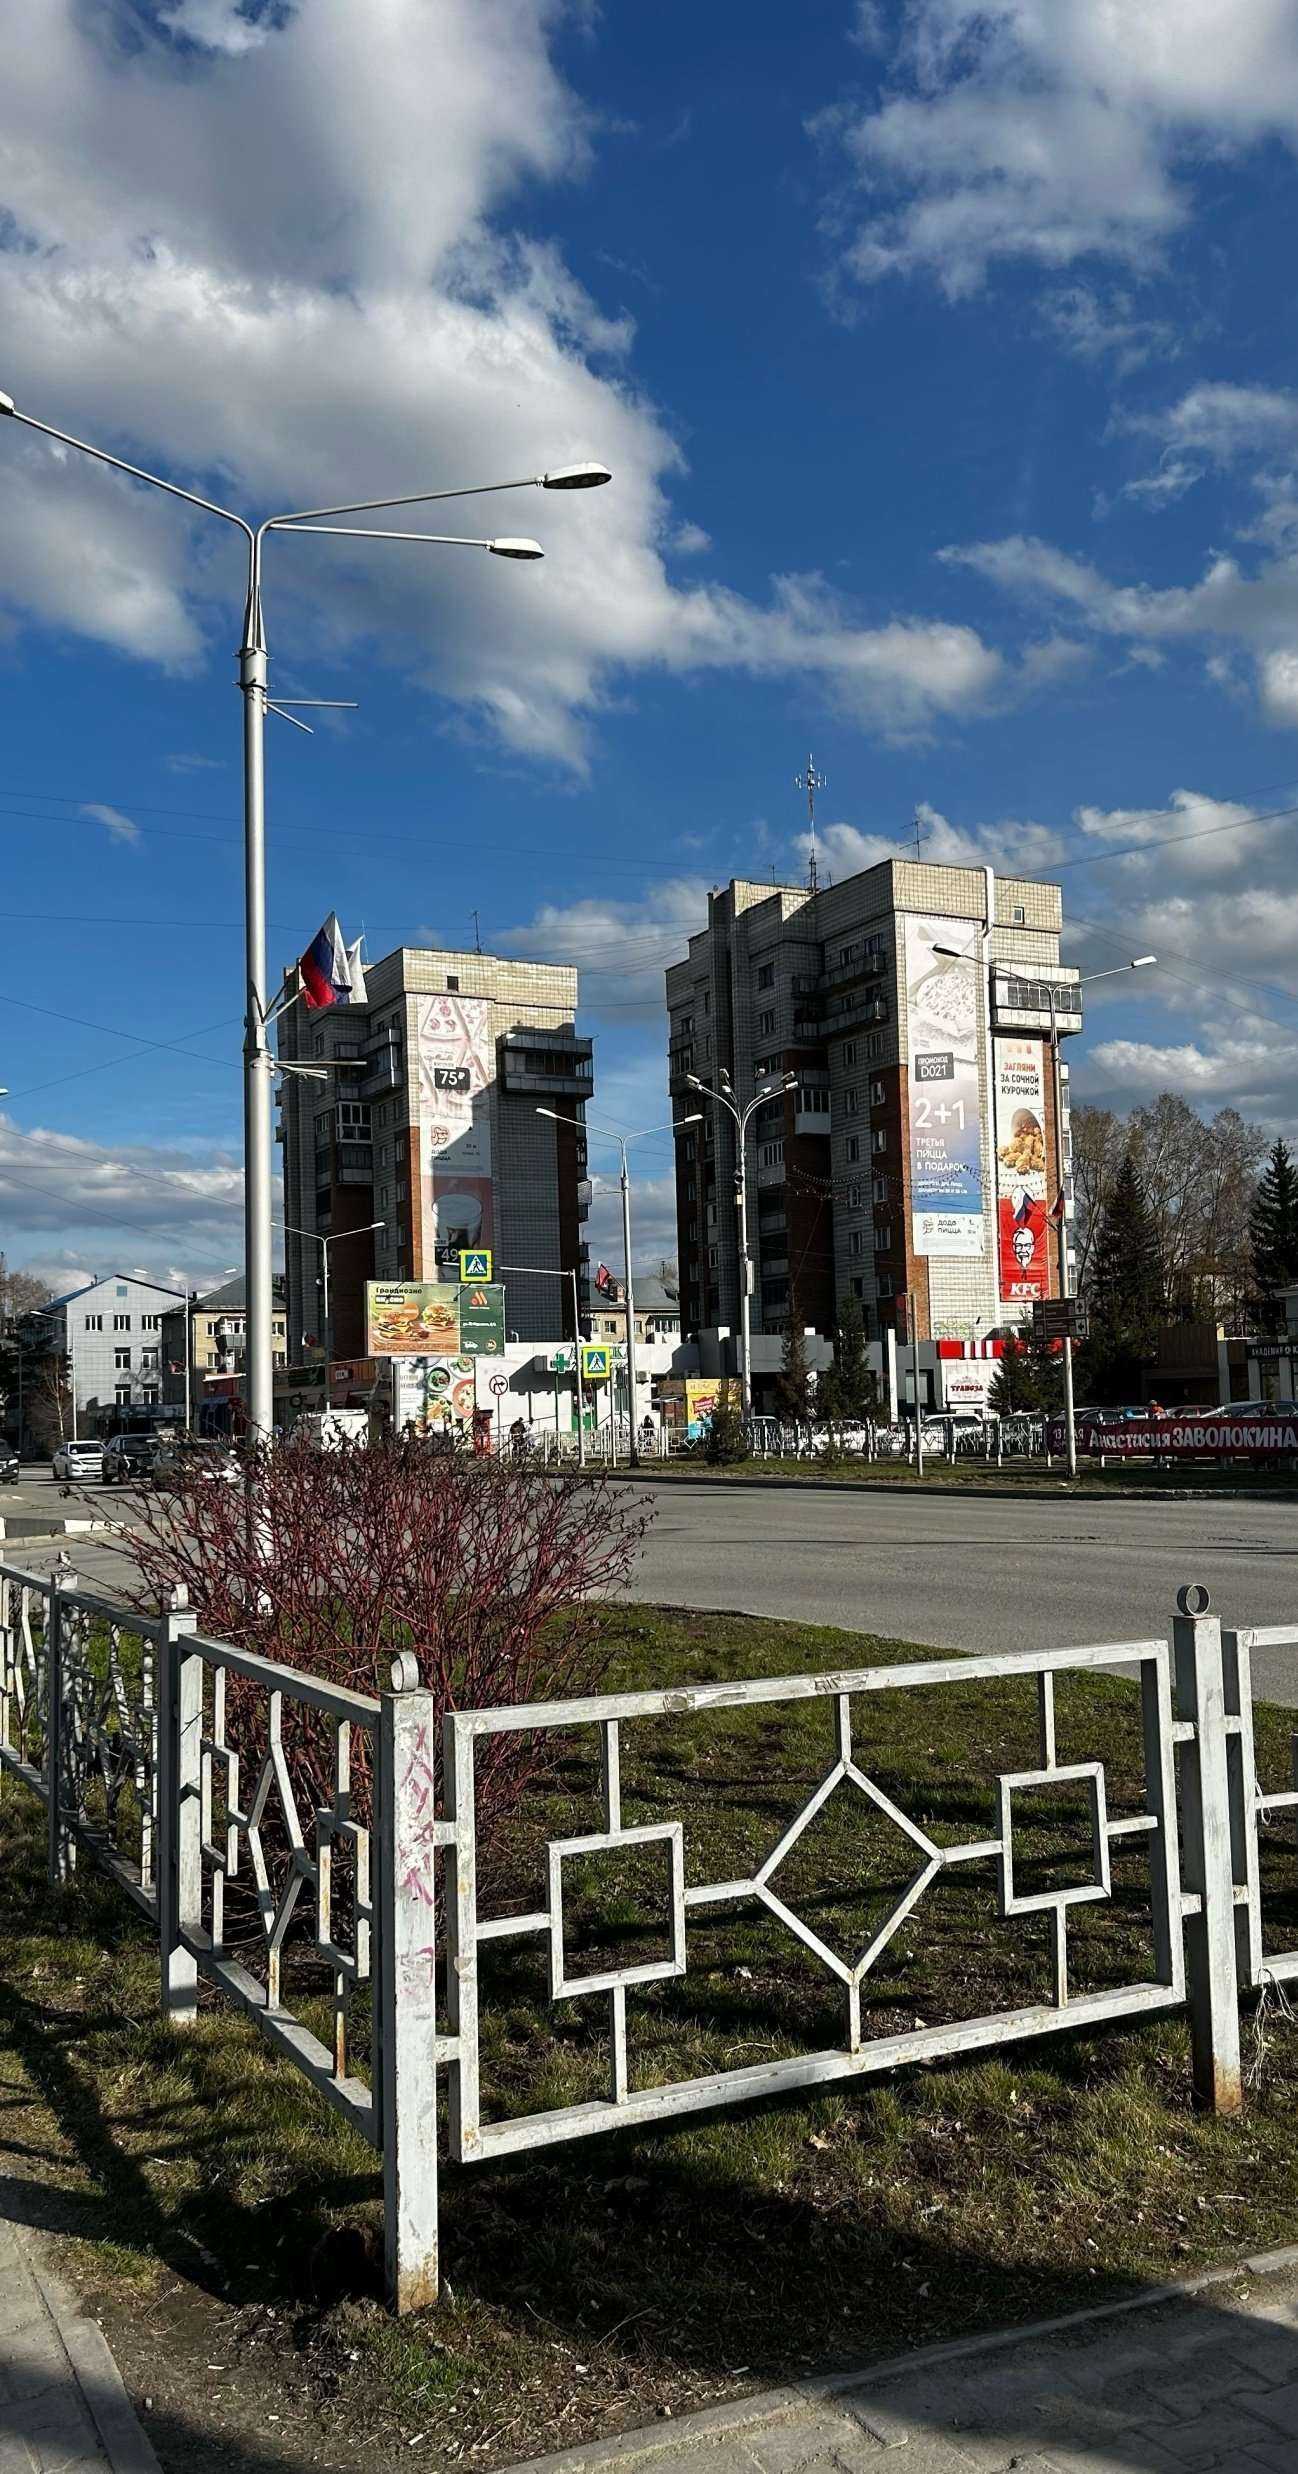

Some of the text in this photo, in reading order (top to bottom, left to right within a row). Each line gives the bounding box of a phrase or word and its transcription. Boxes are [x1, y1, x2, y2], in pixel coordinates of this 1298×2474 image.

[921, 1065, 946, 1078] D021
[1004, 1063, 1036, 1072] ЗАГЛЯНИ
[1000, 1073, 1040, 1085] ЗА СОЧНОЙ
[1001, 1085, 1040, 1096] КУРОЧКОЙ
[915, 1097, 965, 1130] 2+1
[916, 1137, 945, 1147] ТРЕТЬЯ
[916, 1149, 948, 1160] ПИЦЦА
[1009, 1283, 1041, 1298] KFC
[1089, 1426, 1298, 1449] Анастасия ЗАВОЛОКИНА
